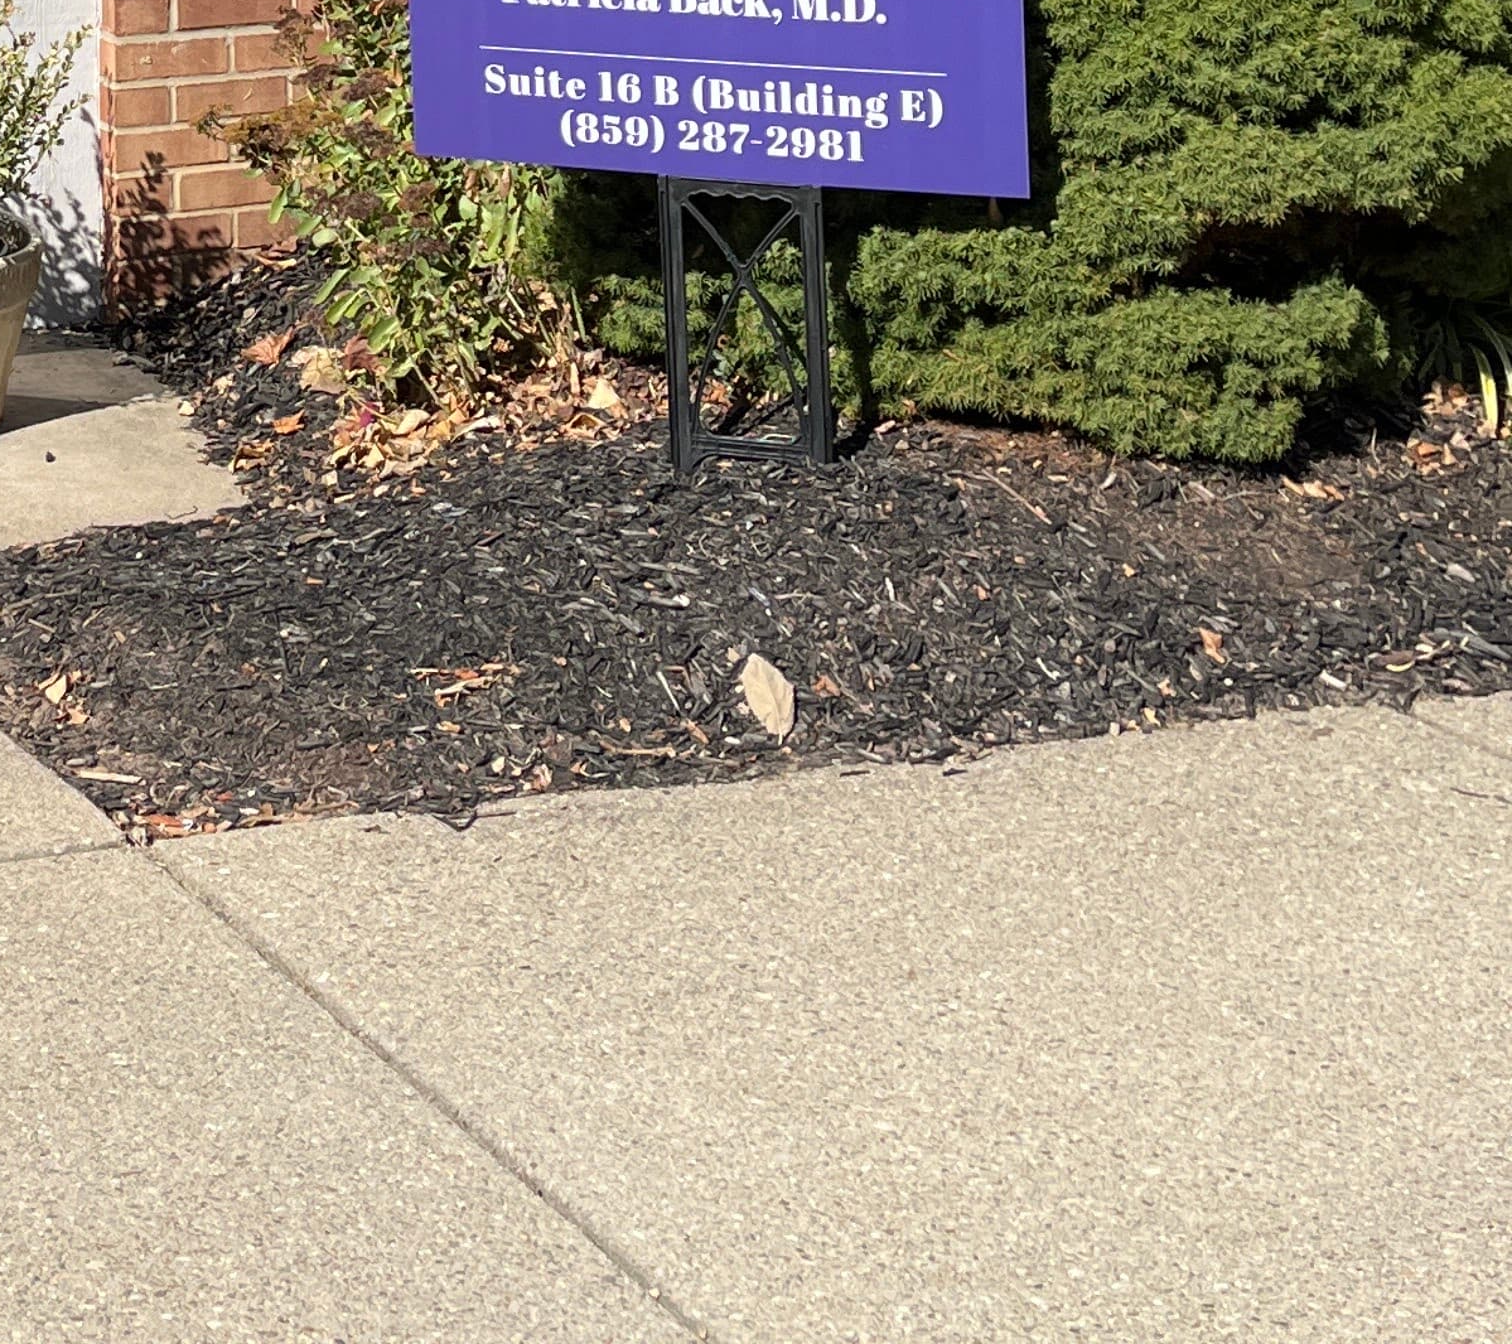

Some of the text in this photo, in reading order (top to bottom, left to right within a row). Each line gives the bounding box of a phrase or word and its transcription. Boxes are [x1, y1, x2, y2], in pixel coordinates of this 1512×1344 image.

[484, 63, 944, 129] Suite 16 B (Building E)
[560, 108, 864, 163] (859) 287-2981
